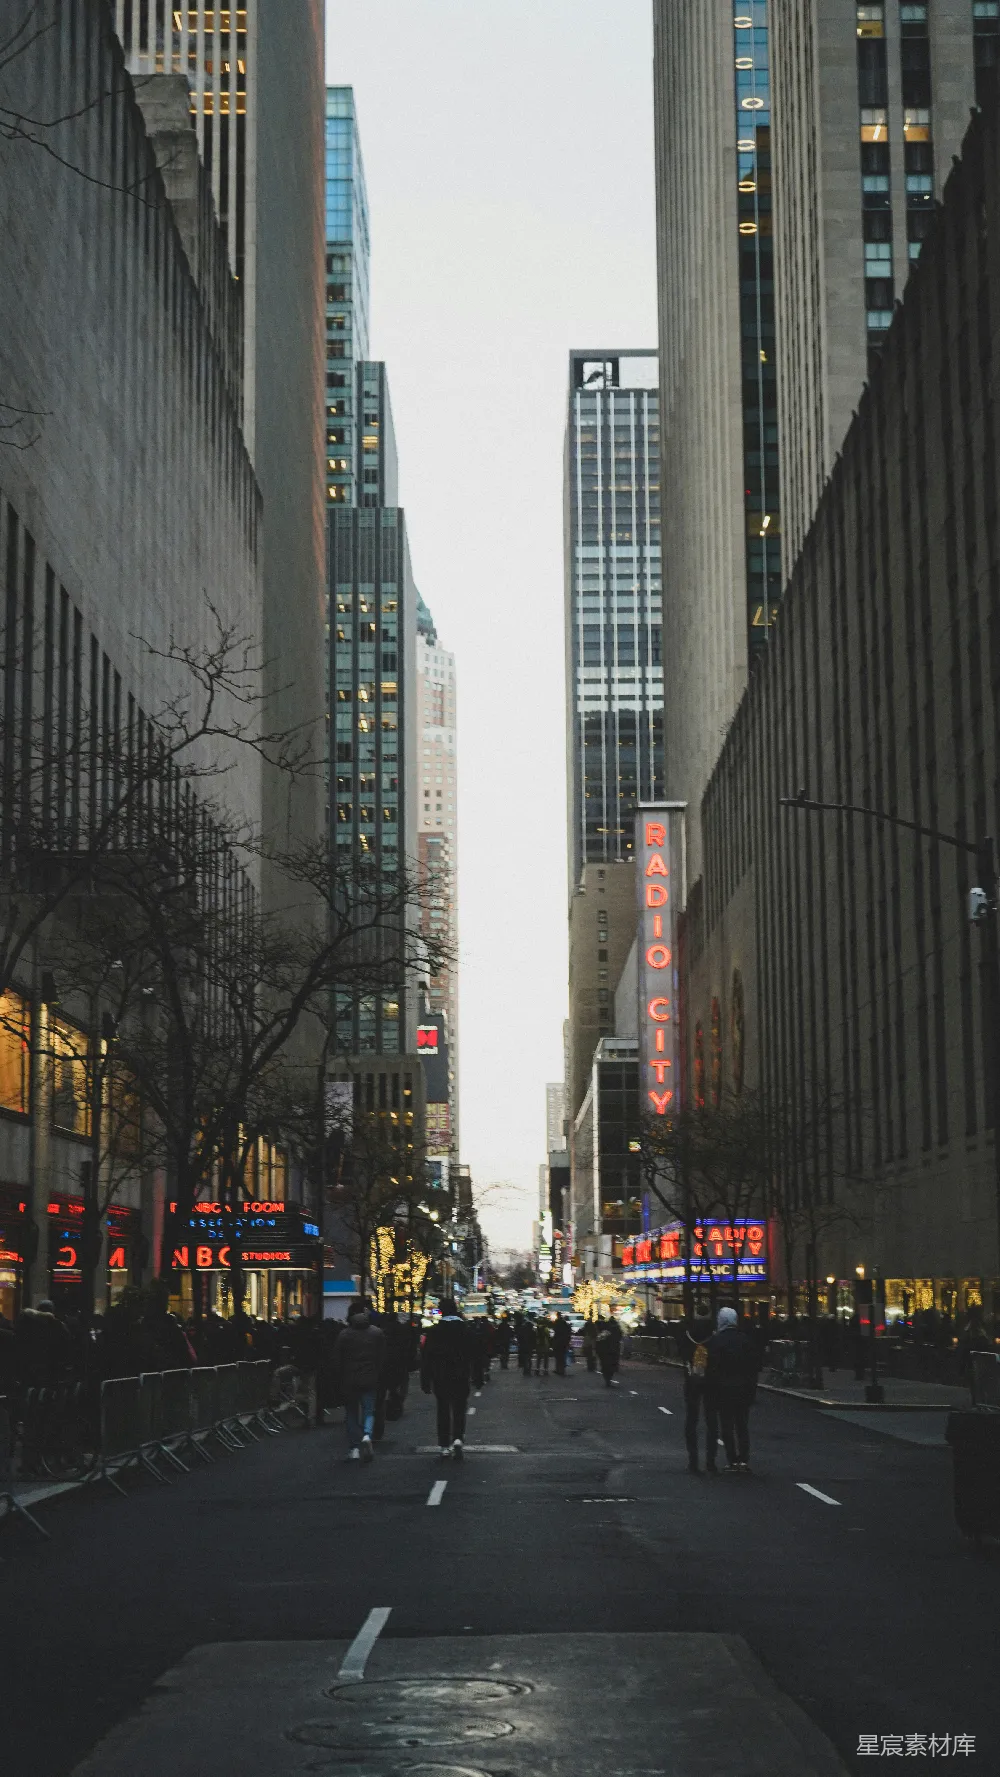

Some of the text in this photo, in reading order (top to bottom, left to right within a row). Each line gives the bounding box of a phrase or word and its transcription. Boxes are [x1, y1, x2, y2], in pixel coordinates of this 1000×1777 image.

[645, 822, 673, 1115] RADIO CITY
[171, 1246, 291, 1267] NBC STUDIOS
[693, 1242, 763, 1256] CITY
